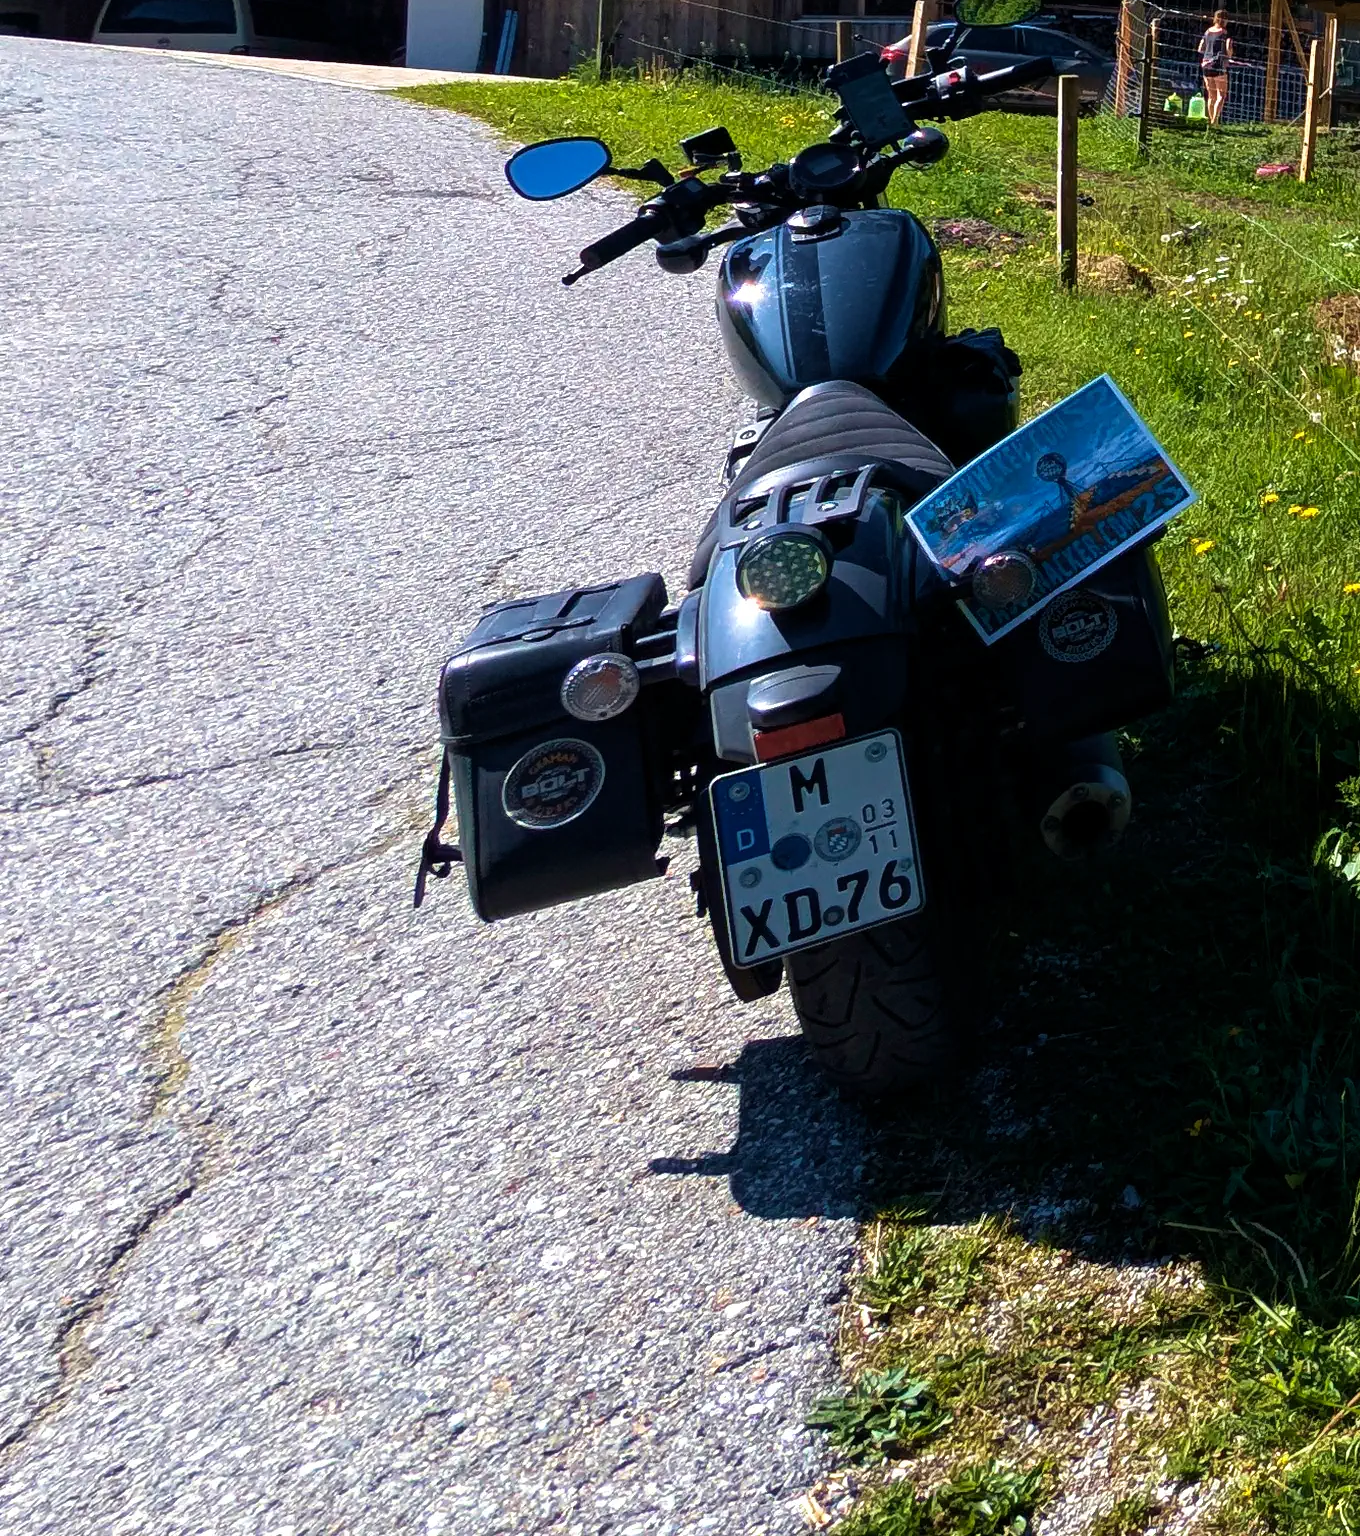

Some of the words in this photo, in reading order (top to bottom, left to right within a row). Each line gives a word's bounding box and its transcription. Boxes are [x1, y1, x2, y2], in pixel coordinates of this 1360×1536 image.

[975, 506, 1140, 632] PNACKER.COM
[1051, 611, 1103, 640] BOLT
[520, 767, 590, 798] BOLT
[789, 758, 830, 813] M
[862, 799, 895, 823] 03
[737, 828, 755, 851] D
[868, 830, 898, 854] 11
[740, 887, 822, 956] XD
[837, 860, 911, 923] 76
